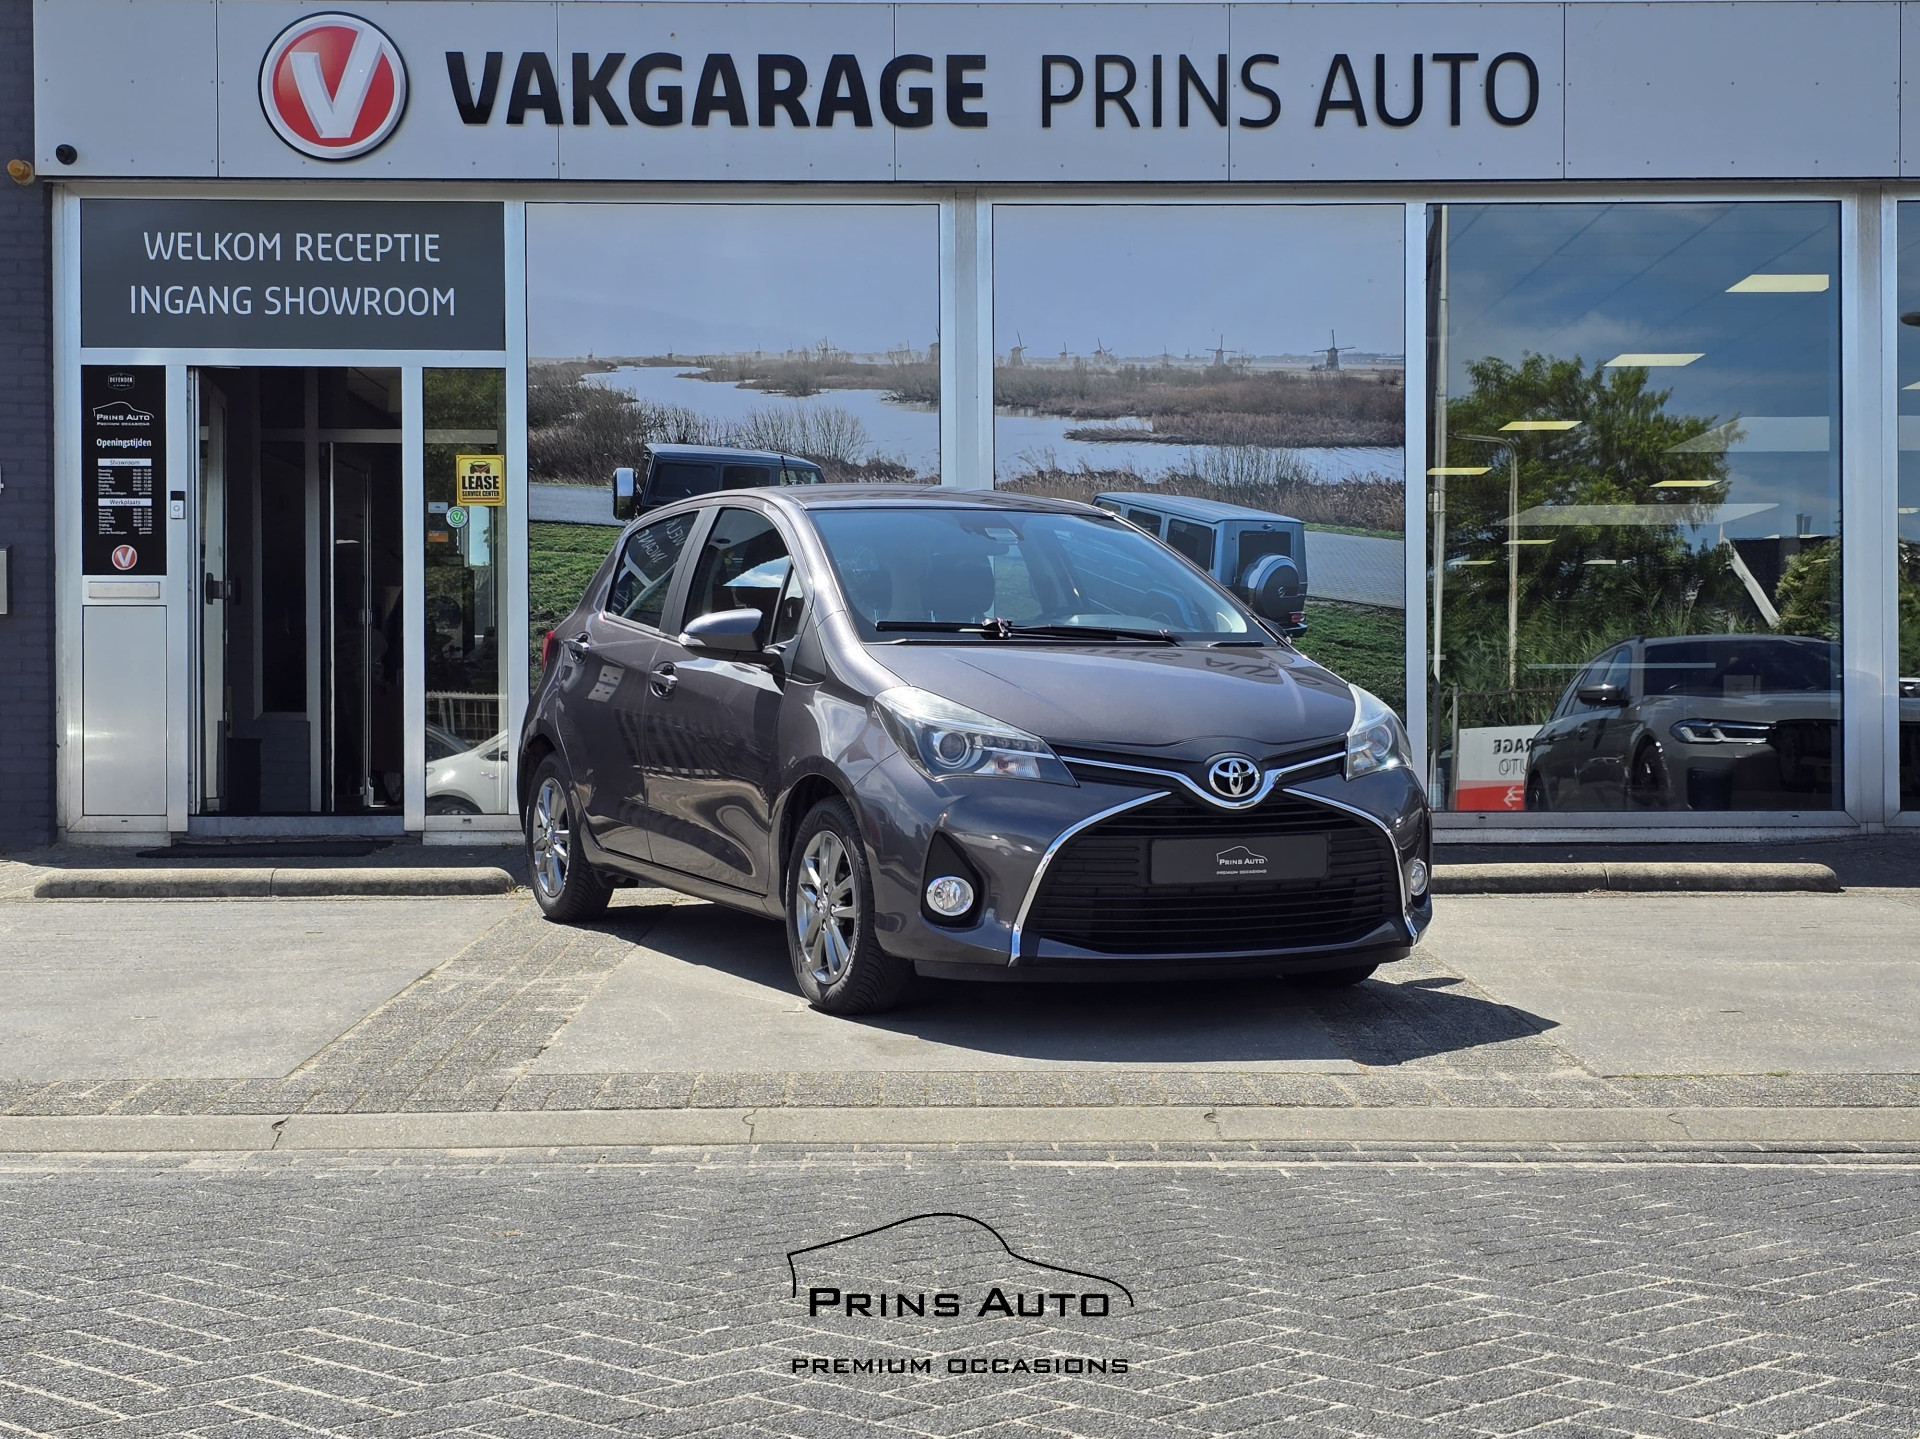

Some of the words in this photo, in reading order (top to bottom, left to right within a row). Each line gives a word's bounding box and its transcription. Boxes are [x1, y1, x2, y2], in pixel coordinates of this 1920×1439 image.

[289, 27, 383, 139] V
[445, 51, 988, 128] VAKGARAGE
[1041, 53, 1282, 128] PRINS
[1314, 52, 1539, 127] AUTO
[143, 231, 281, 261] WELKOM
[295, 233, 440, 262] RECEPTIE
[130, 285, 252, 315] INGANG
[264, 286, 455, 316] SHOWROOM
[96, 437, 152, 449] Openingstijden
[461, 475, 500, 490] LEASE
[109, 498, 141, 507] Werkplaats
